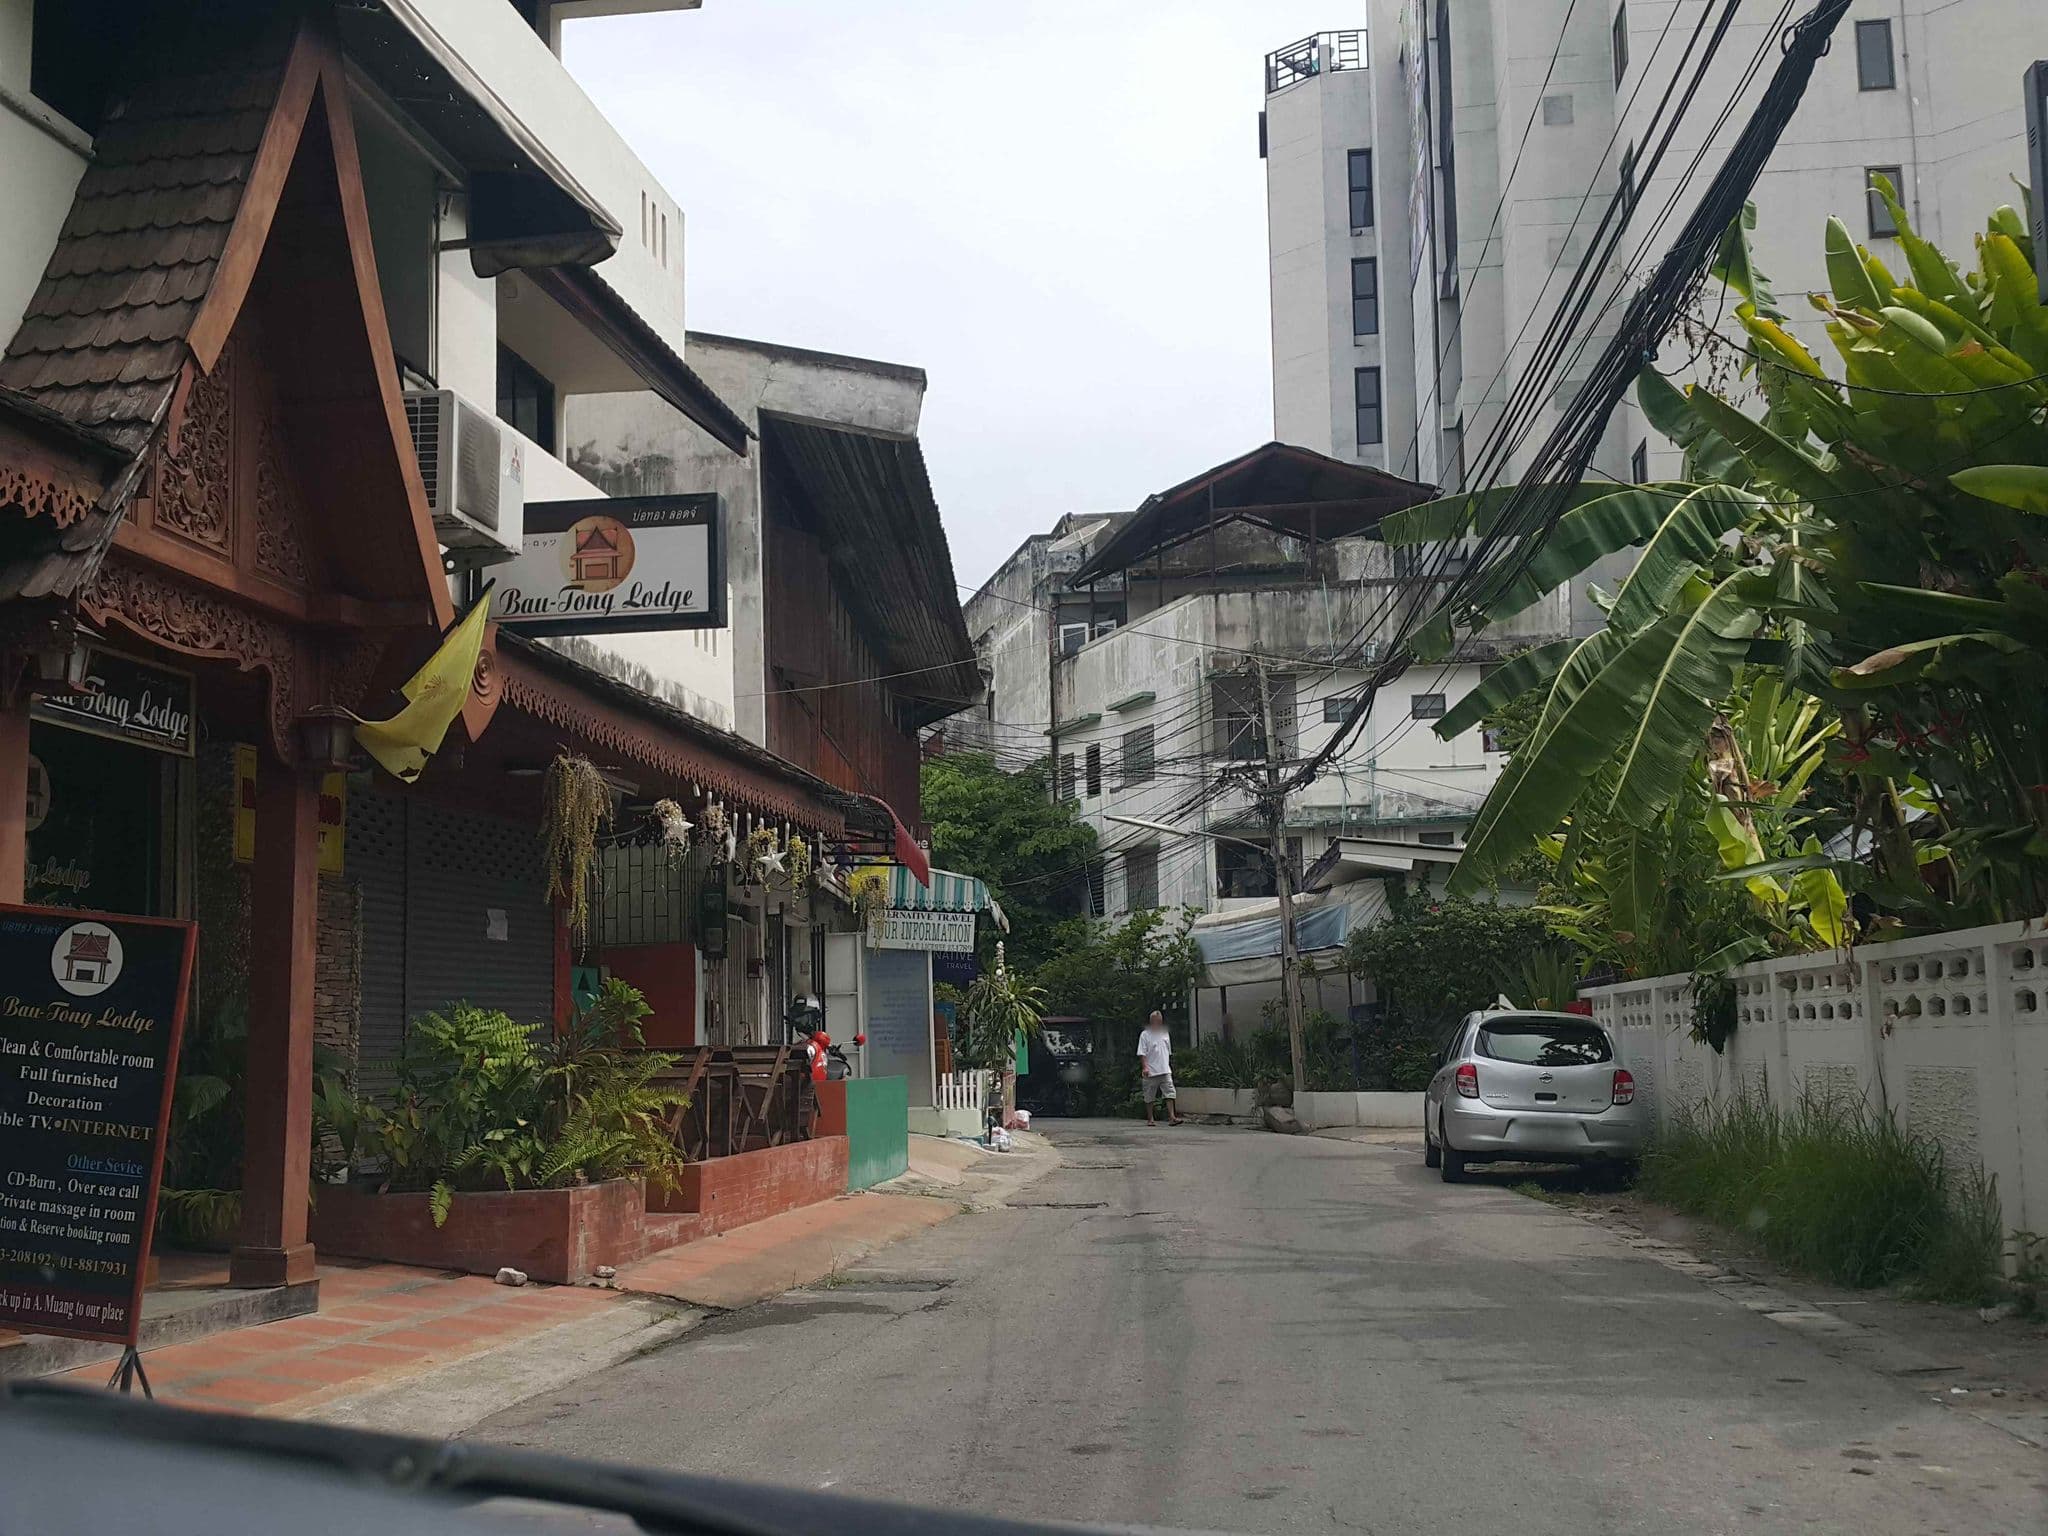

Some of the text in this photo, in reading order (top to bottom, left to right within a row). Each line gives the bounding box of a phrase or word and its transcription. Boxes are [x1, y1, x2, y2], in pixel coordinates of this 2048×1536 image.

[501, 581, 693, 616] Bau-Tong Lodge
[133, 690, 188, 740] Lodge
[938, 913, 973, 923] TRAVEL
[901, 922, 972, 942] INFORMATION
[946, 962, 972, 971] TRAVEL
[3, 996, 155, 1034] Bau-Tong Lodge
[29, 1039, 41, 1057] &
[45, 1041, 119, 1066] Comfortable
[122, 1054, 154, 1069] room
[20, 1065, 119, 1089] Full furnished
[27, 1091, 103, 1112] Decoration
[67, 1154, 144, 1175] Other Sevice
[68, 1178, 96, 1194] Over
[98, 1186, 115, 1197] sea
[119, 1185, 140, 1200] call
[39, 1200, 86, 1220] massage
[89, 1203, 100, 1219] in
[104, 1208, 136, 1222] room
[18, 1217, 28, 1232] &
[30, 1218, 65, 1237] Reserve
[67, 1223, 104, 1245] booking
[105, 1231, 131, 1245] room
[60, 1255, 127, 1276] 01-8817931
[10, 1294, 21, 1313] up
[22, 1292, 31, 1310] in
[33, 1295, 42, 1311] A.
[44, 1294, 74, 1320] Muang
[75, 1300, 84, 1316] to
[85, 1304, 100, 1318] our
[101, 1302, 125, 1324] place
